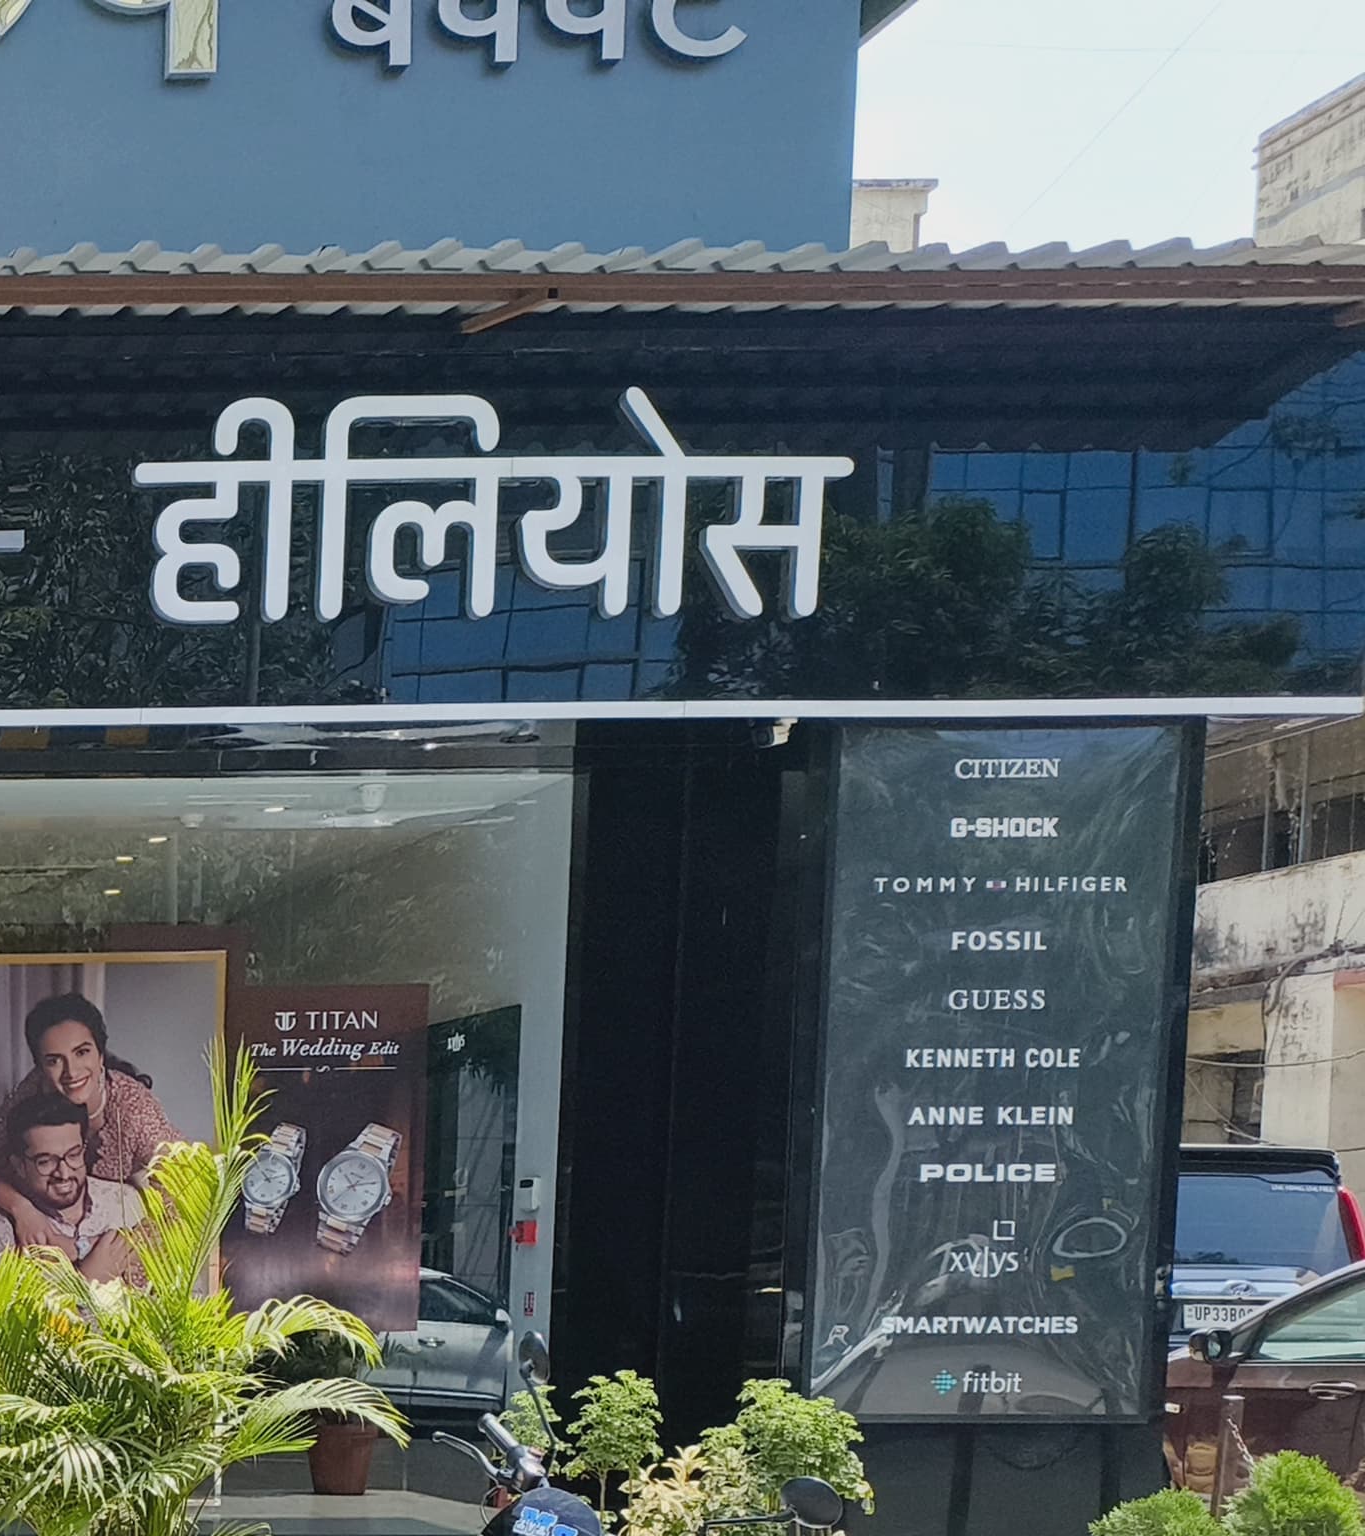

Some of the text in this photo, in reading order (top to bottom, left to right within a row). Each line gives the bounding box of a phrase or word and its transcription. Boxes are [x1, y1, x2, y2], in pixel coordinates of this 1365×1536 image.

[134, 386, 855, 626] हीलियोस
[954, 758, 1061, 779] CITIZEN
[950, 816, 1059, 838] G-SHOCK
[874, 876, 1128, 893] TOMMY HILFIGER
[951, 930, 1047, 951] FOSSIL
[948, 989, 1047, 1010] GUESS
[305, 1011, 379, 1030] TITAN
[251, 1037, 400, 1061] The Wedding Edit
[905, 1047, 1081, 1068] KENNETH COLE
[907, 1106, 1074, 1126] ANNE KLEIN
[919, 1163, 1057, 1183] POLICE
[1195, 1306, 1254, 1322] UP33B0
[881, 1316, 1078, 1335] SMARTWATCHES
[962, 1370, 1022, 1394] fitbit
